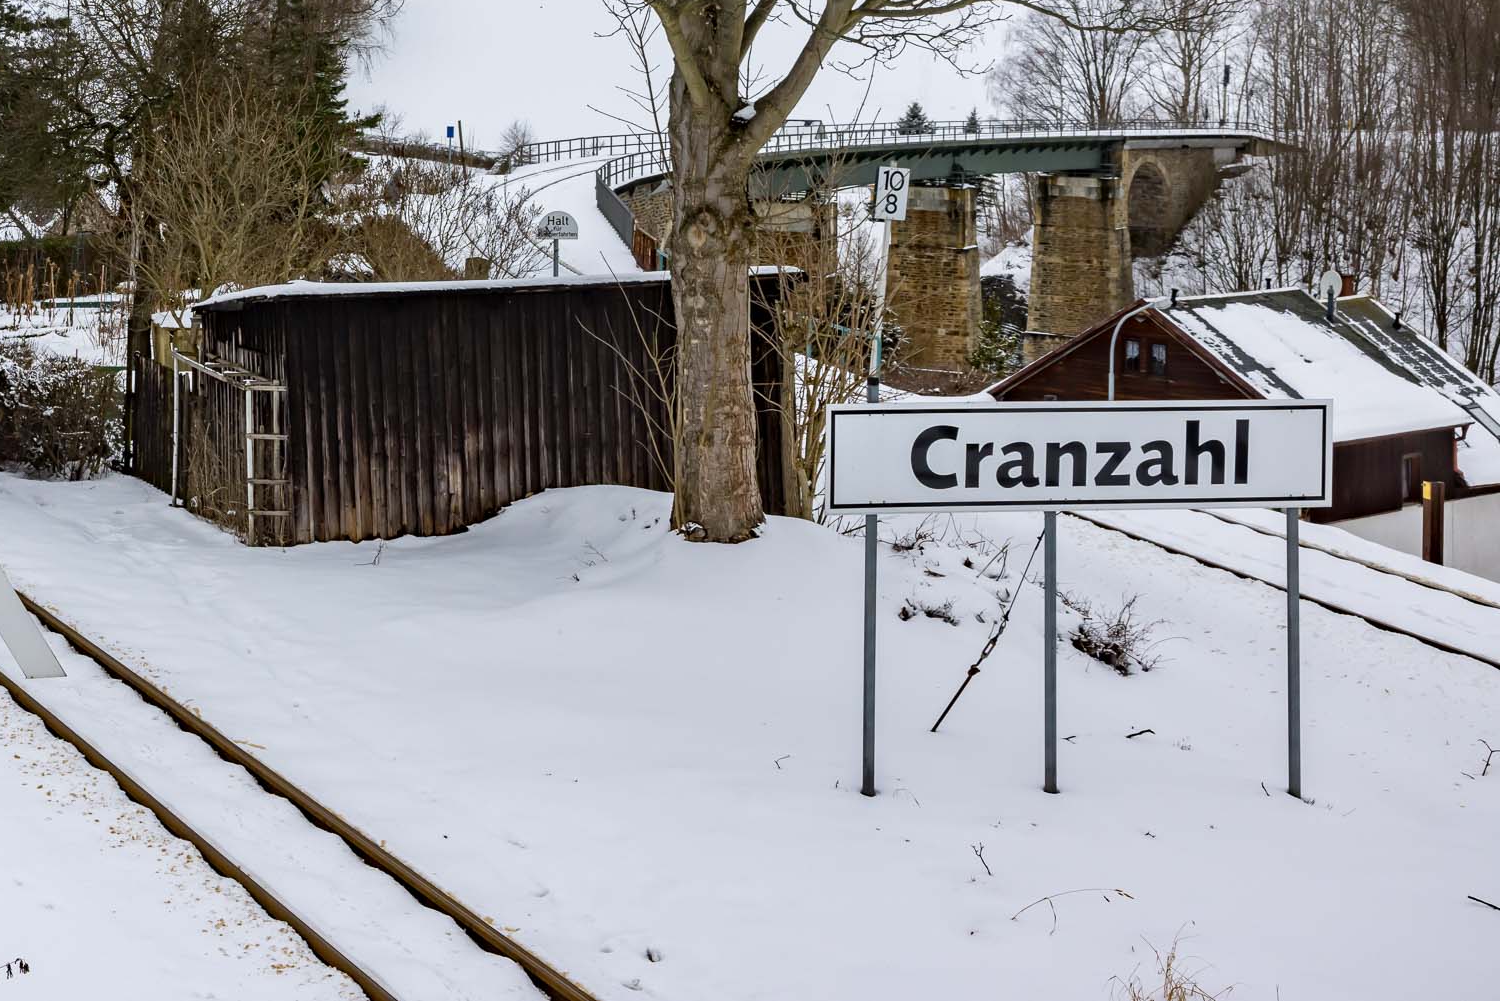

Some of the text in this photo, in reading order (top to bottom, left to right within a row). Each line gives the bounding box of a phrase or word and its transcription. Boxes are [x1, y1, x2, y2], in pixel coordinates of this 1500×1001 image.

[884, 170, 904, 191] 10
[885, 194, 897, 214] 8
[547, 215, 569, 226] Halt
[911, 419, 1250, 490] Cranzahl
